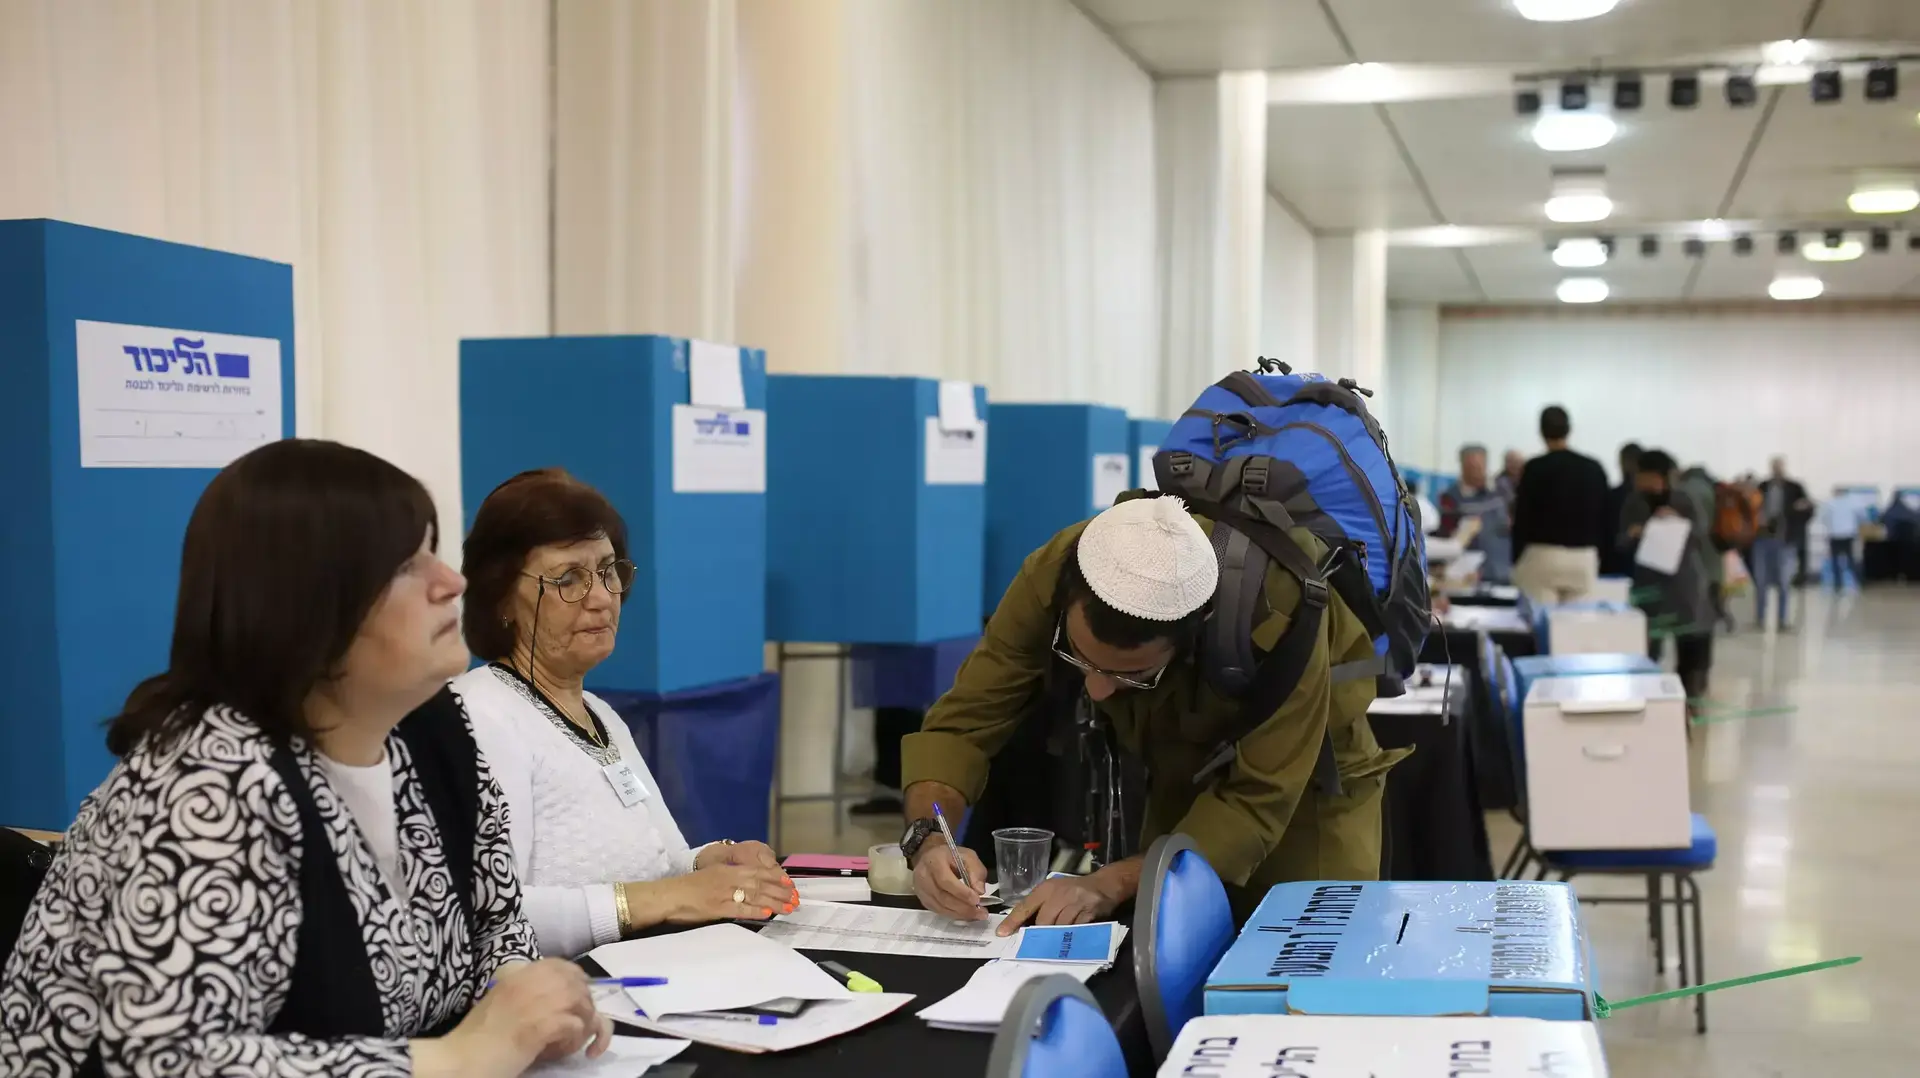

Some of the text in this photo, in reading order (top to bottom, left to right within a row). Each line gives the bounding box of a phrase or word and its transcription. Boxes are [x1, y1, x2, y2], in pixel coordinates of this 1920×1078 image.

[122, 336, 212, 376] הליכוד
[125, 378, 154, 390] לכנסת
[157, 380, 184, 392] הליכוד
[187, 382, 220, 394] לרשימת
[1304, 884, 1363, 914] בחירות
[1266, 941, 1338, 977] התנועה
